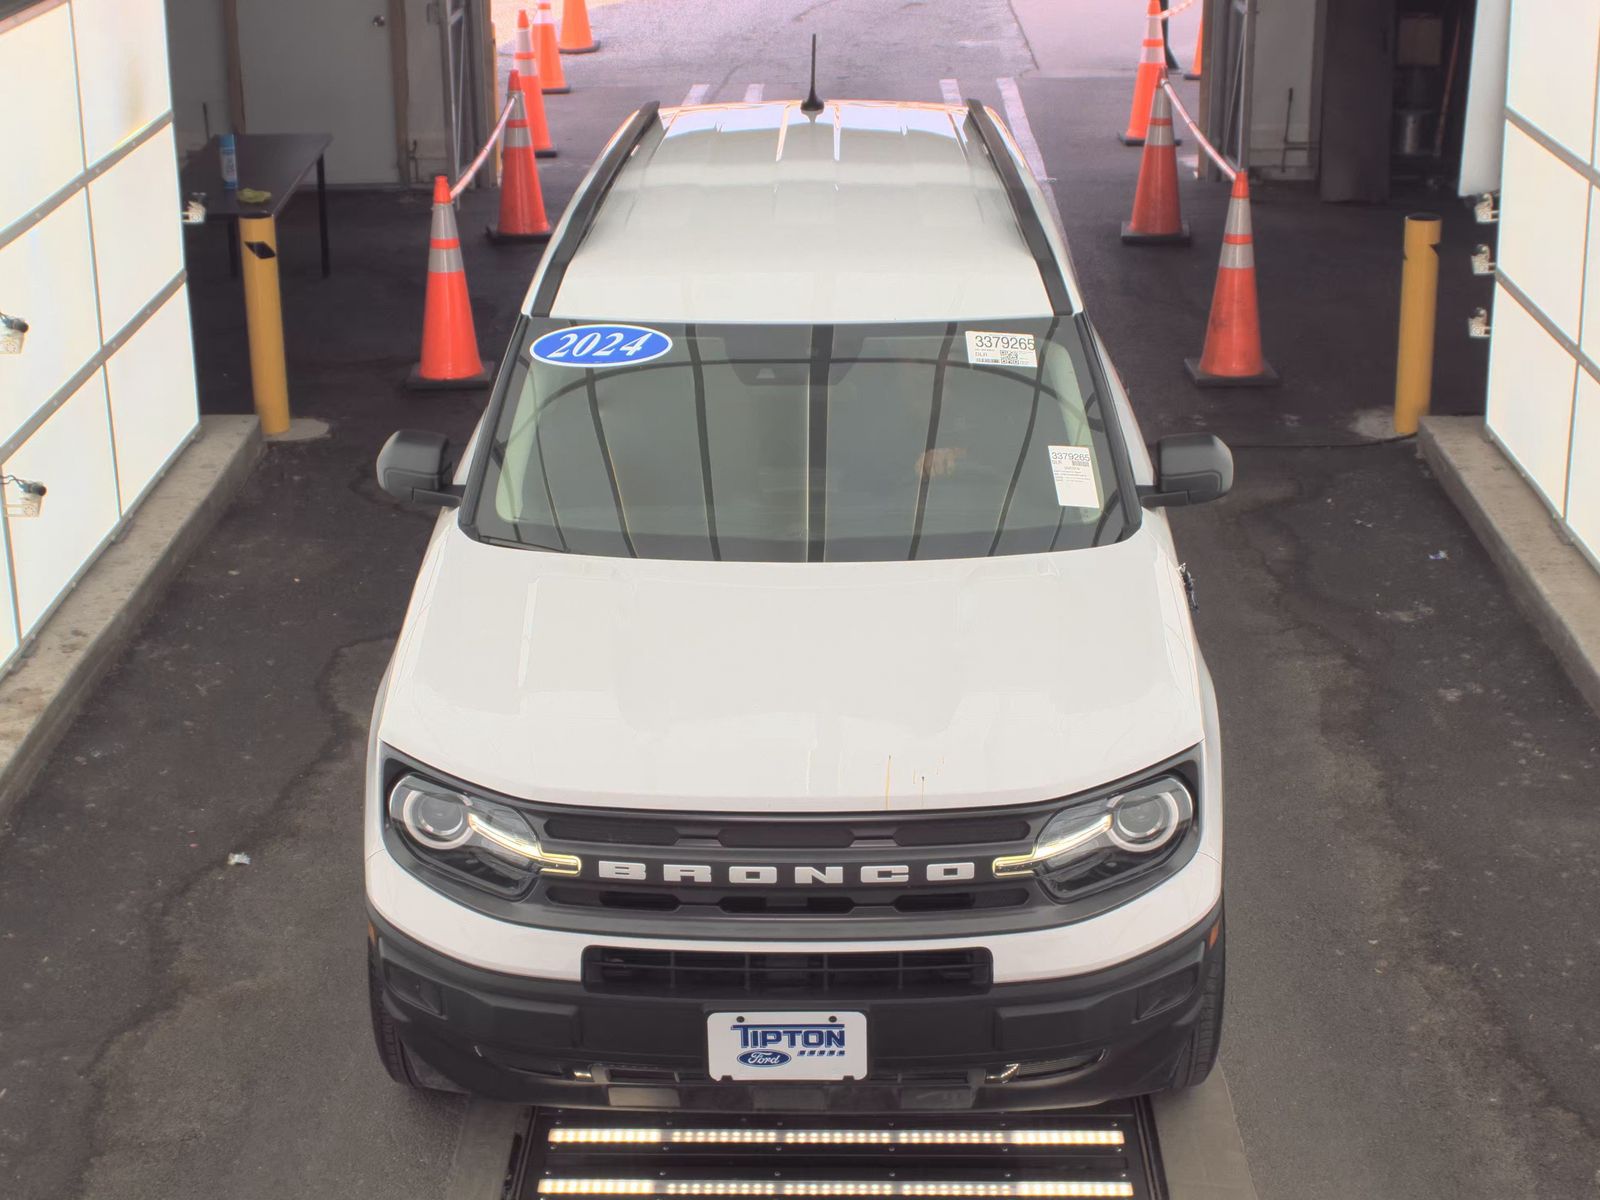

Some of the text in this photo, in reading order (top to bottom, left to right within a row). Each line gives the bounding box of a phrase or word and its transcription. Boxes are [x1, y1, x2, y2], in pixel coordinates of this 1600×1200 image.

[547, 332, 653, 358] 2024
[975, 335, 1036, 351] 3379265
[599, 860, 975, 884] BRONCO
[731, 1024, 845, 1048] TIPTON
[748, 1051, 780, 1065] Ford
